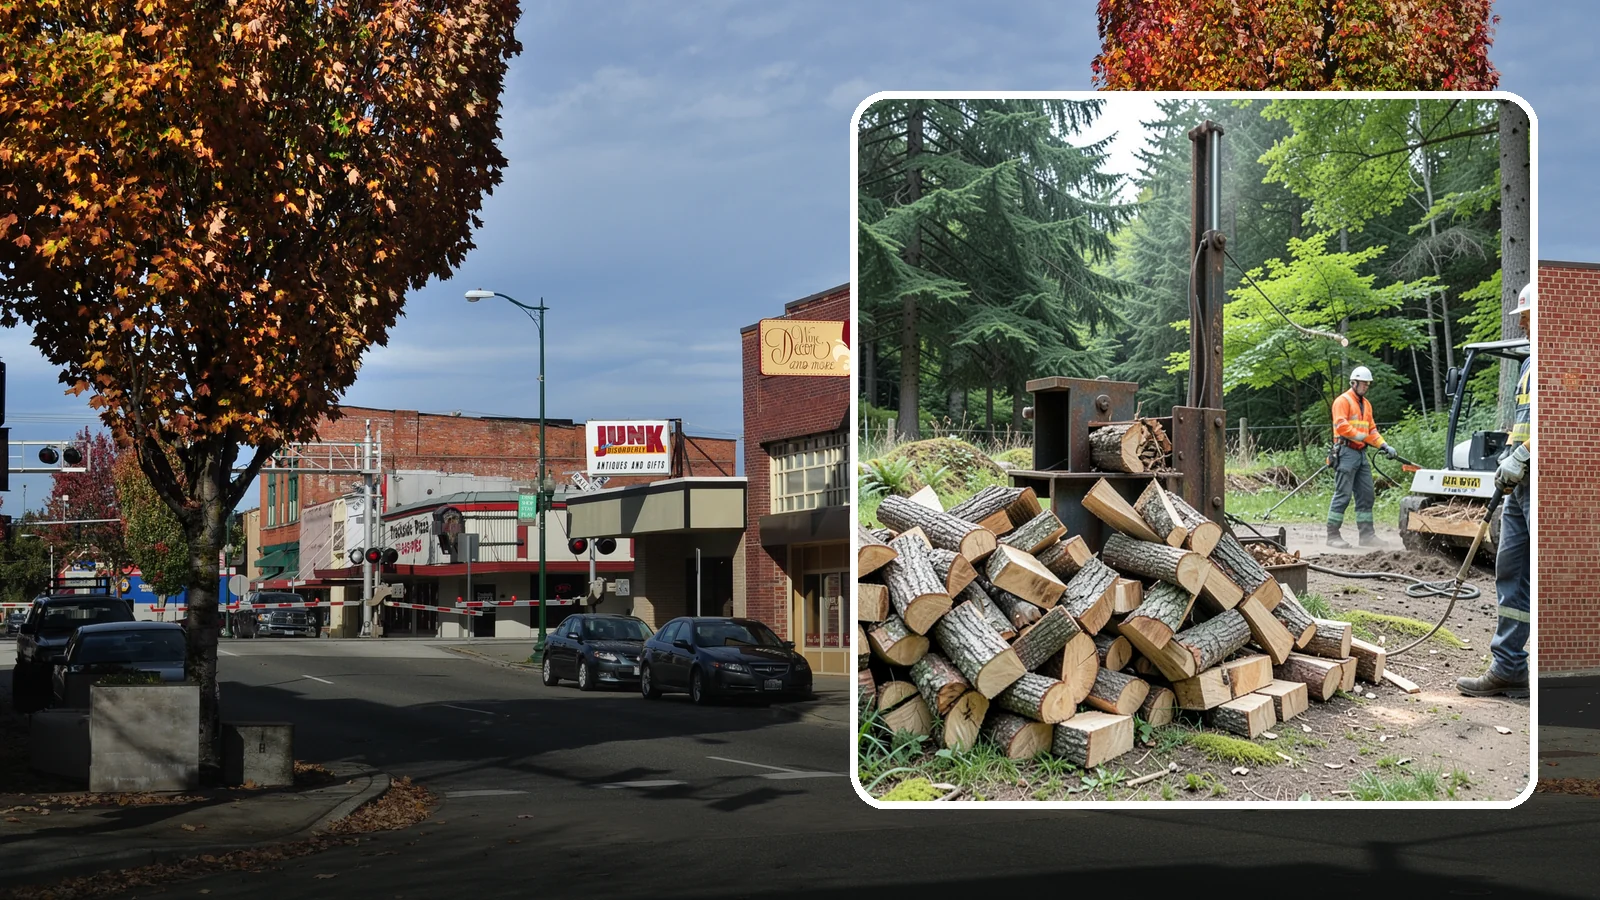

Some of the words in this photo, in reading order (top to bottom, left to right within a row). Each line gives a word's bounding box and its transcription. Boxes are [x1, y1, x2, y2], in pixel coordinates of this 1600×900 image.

[595, 425, 665, 457] JUNK
[607, 445, 646, 454] DISORDERLY
[596, 461, 628, 470] ANTIQUES
[631, 461, 644, 470] AND
[647, 460, 665, 470] GIFTS
[415, 519, 429, 535] Pizza
